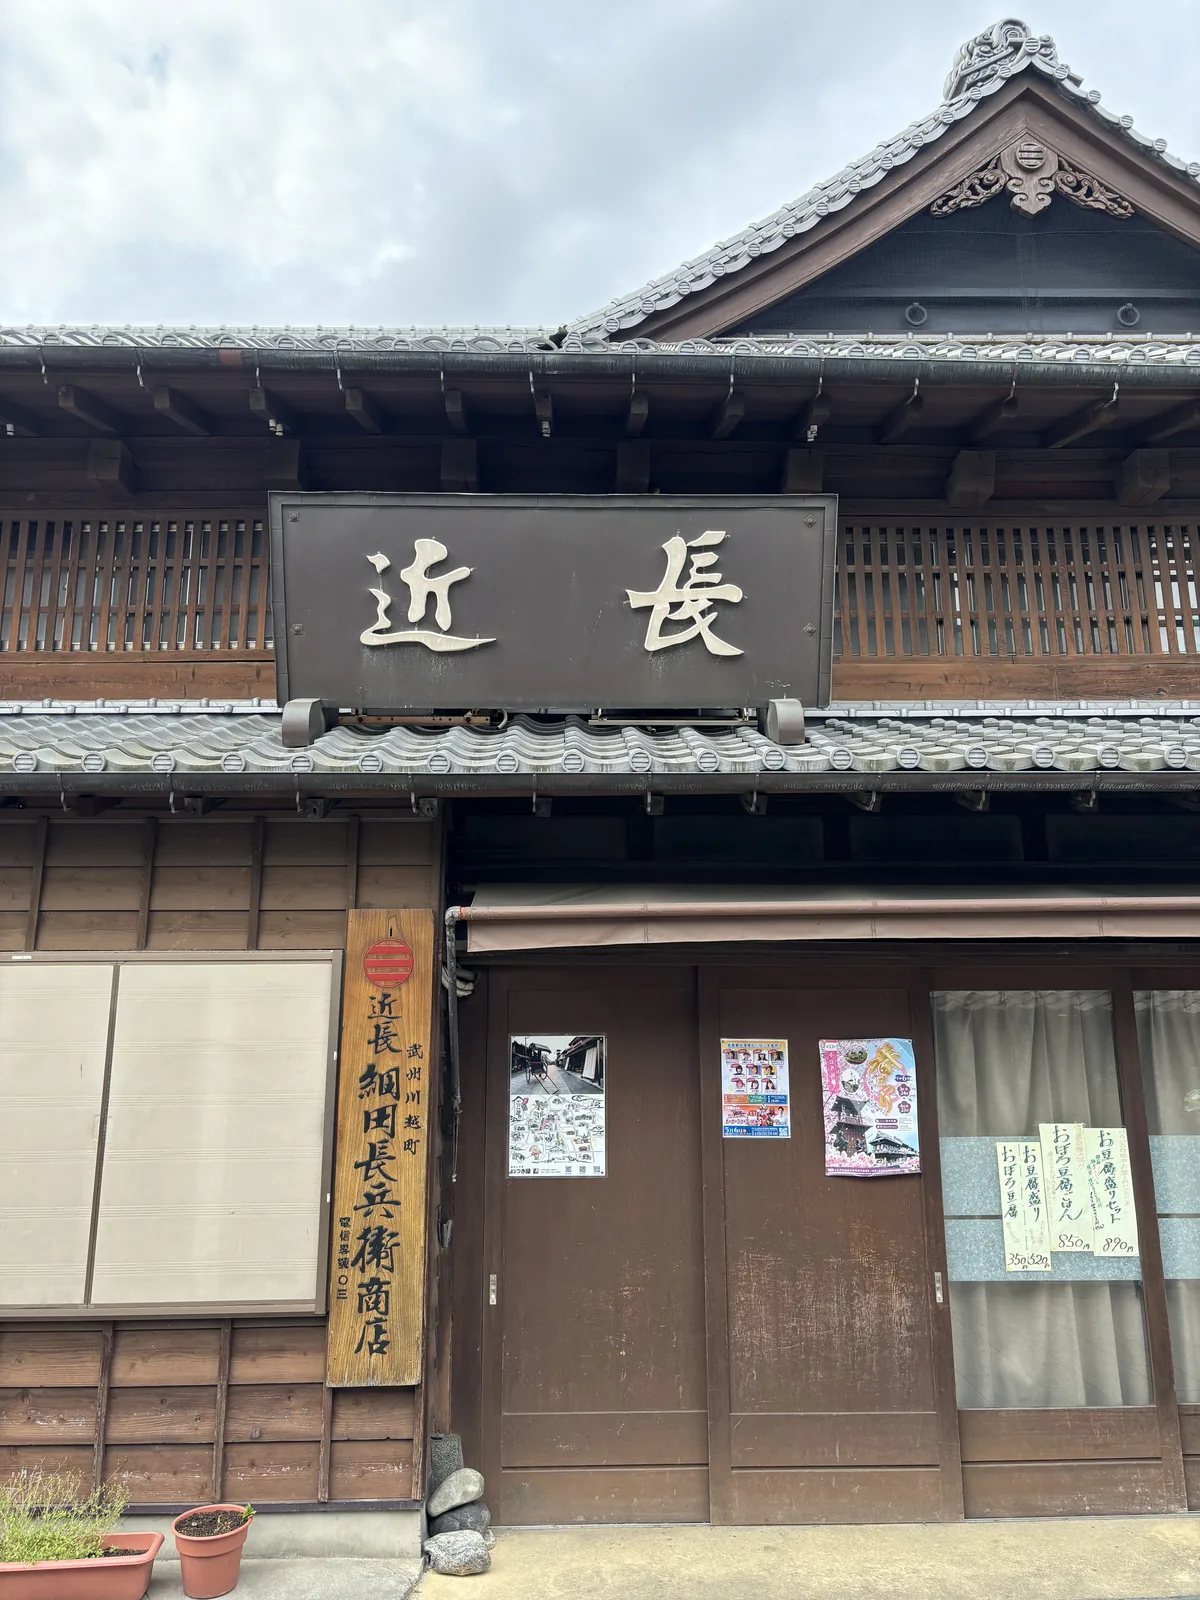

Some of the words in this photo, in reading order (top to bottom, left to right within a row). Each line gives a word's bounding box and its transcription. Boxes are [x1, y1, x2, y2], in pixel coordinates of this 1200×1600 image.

[360, 531, 745, 656] 近長
[404, 1044, 423, 1155] 武州川越町
